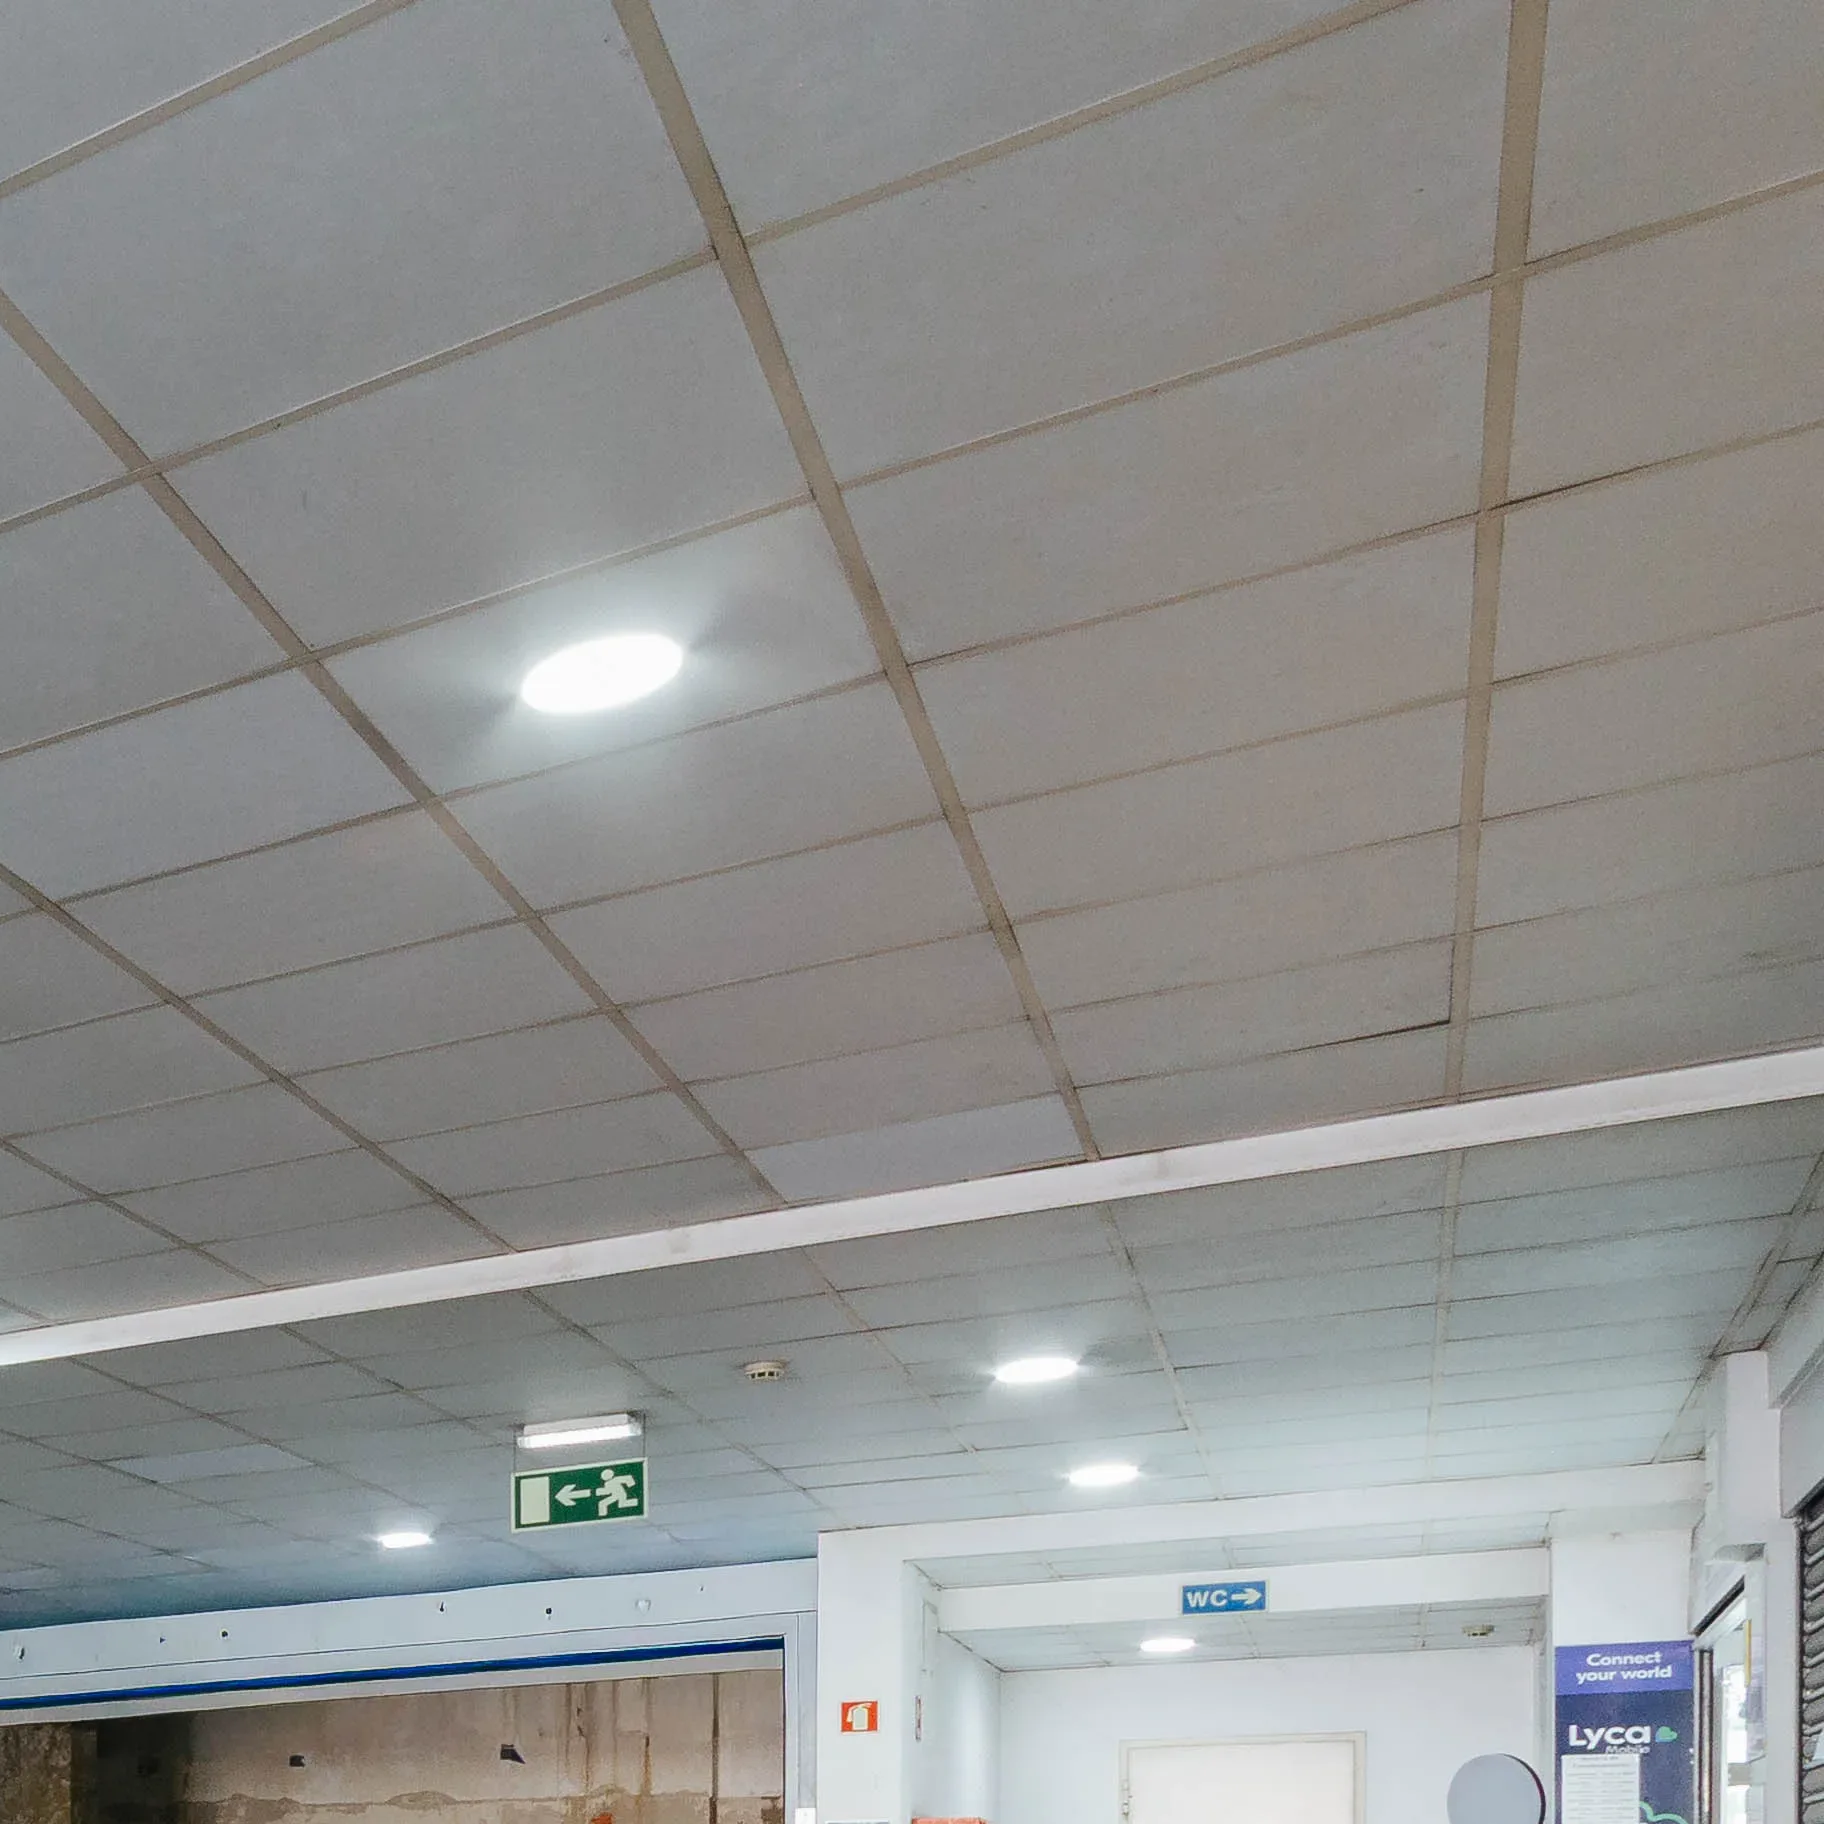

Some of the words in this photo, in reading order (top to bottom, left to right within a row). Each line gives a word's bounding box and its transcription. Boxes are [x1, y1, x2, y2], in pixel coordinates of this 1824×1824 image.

[1186, 1589, 1228, 1608] WC
[1586, 1651, 1662, 1667] Connect
[1575, 1670, 1617, 1685] your
[1620, 1665, 1672, 1680] world
[1568, 1724, 1651, 1750] Lyca
